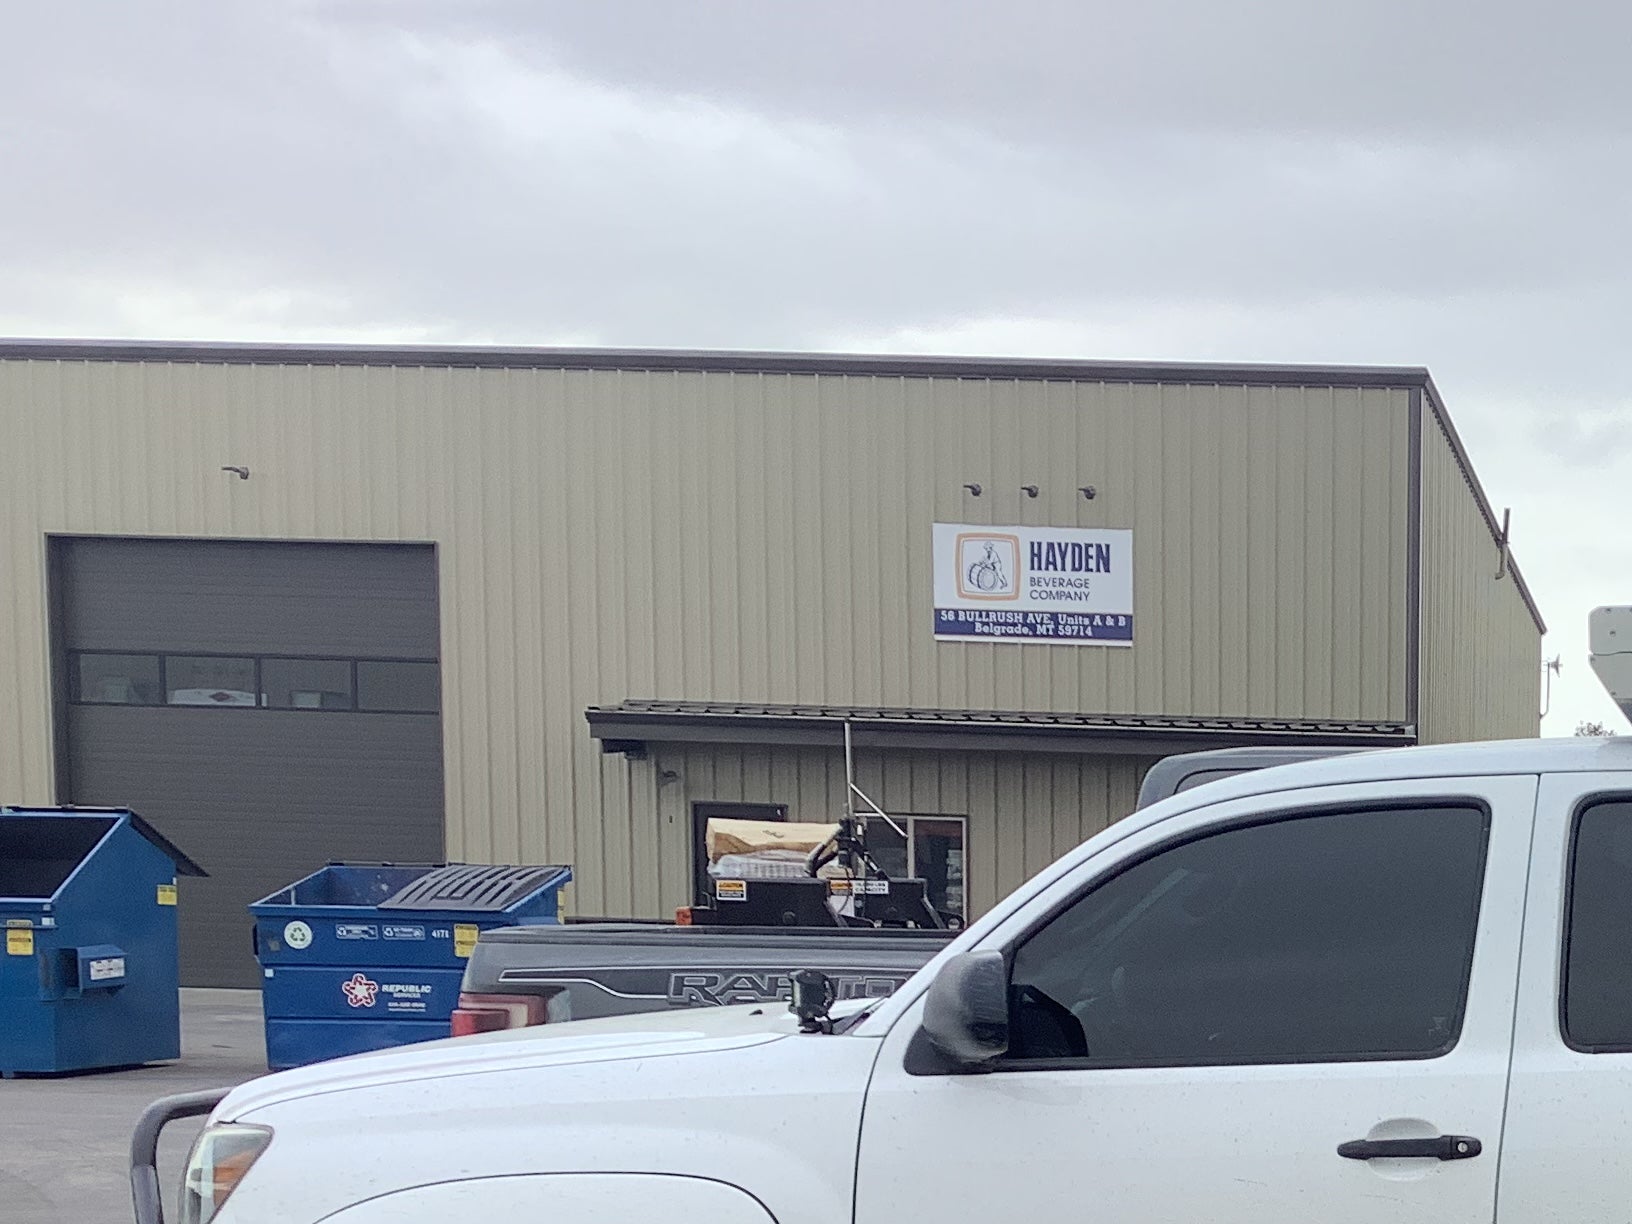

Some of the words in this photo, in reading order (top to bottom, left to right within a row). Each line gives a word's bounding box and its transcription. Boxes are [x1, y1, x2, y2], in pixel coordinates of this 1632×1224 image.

[1030, 541, 1111, 573] HAYDEN
[1029, 576, 1090, 589] BEVERAGE
[1029, 589, 1090, 601] COMPANY
[958, 610, 1024, 623] BULLRUSH
[1058, 613, 1090, 625] Units
[1092, 614, 1103, 626] A
[1105, 615, 1115, 626] &
[1118, 615, 1126, 626] B
[1036, 624, 1055, 635] MT
[1057, 625, 1093, 637] 59714
[381, 984, 432, 993] REPUBLIC
